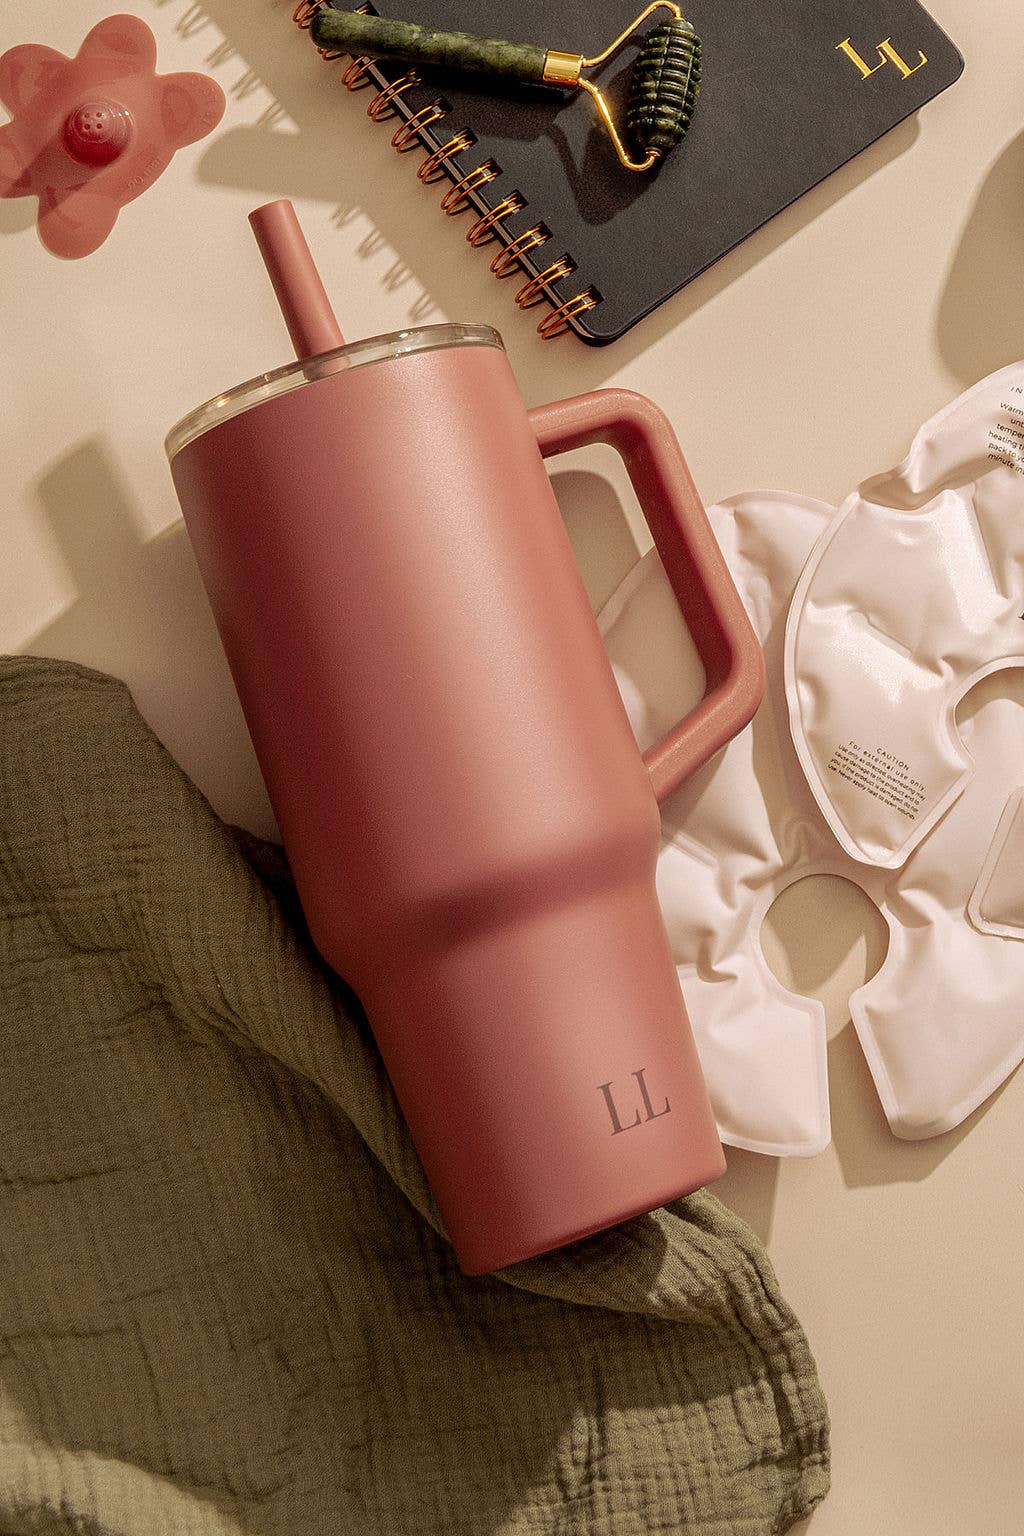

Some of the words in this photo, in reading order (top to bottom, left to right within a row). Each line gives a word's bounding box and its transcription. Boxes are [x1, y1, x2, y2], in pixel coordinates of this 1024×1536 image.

[834, 36, 929, 81] LL
[1000, 402, 1024, 416] Warm
[988, 430, 1018, 449] heating
[987, 442, 1006, 454] pack
[1007, 450, 1015, 458] to
[987, 453, 1015, 469] minute
[876, 747, 910, 771] CAUTION
[895, 770, 909, 780] use
[597, 1068, 671, 1136] LL
